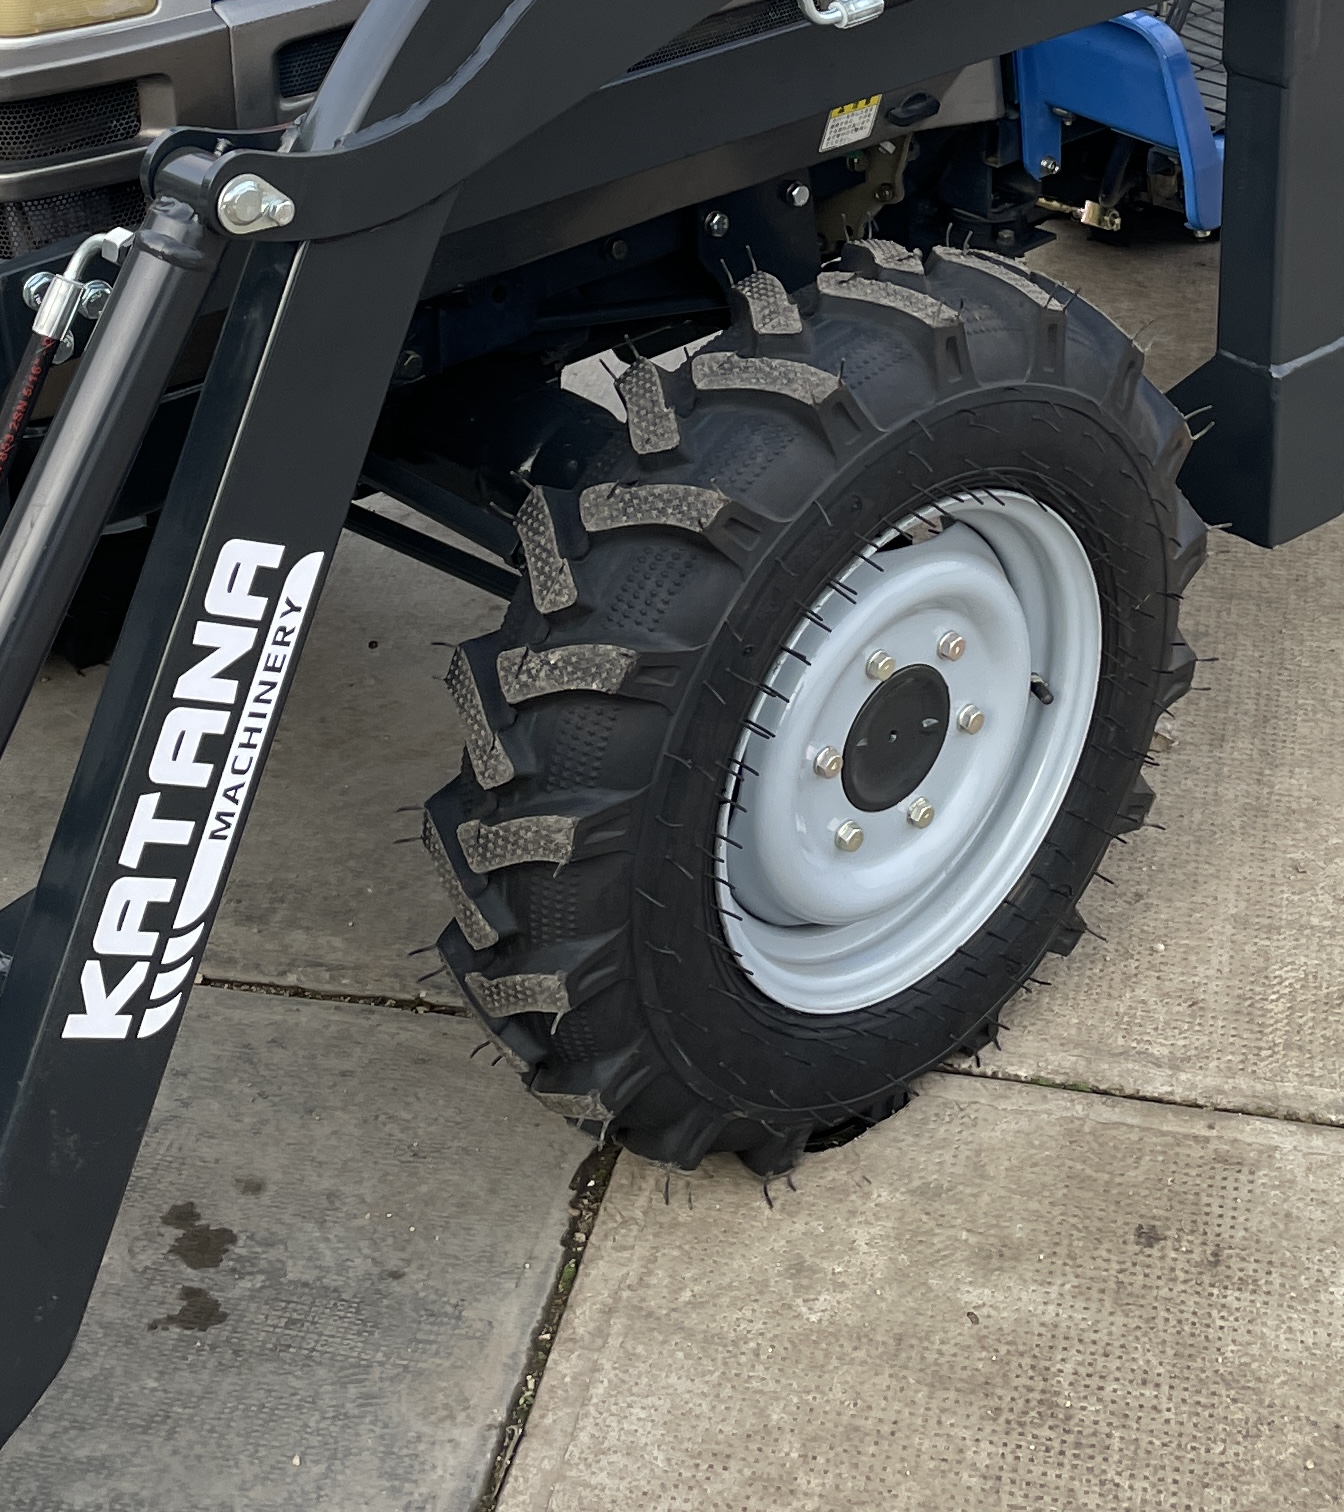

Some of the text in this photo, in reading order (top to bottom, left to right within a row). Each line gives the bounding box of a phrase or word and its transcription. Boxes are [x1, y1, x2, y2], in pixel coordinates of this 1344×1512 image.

[6, 399, 29, 431] 2SN
[61, 538, 286, 1039] KATANA
[208, 596, 302, 841] MACHINERY
